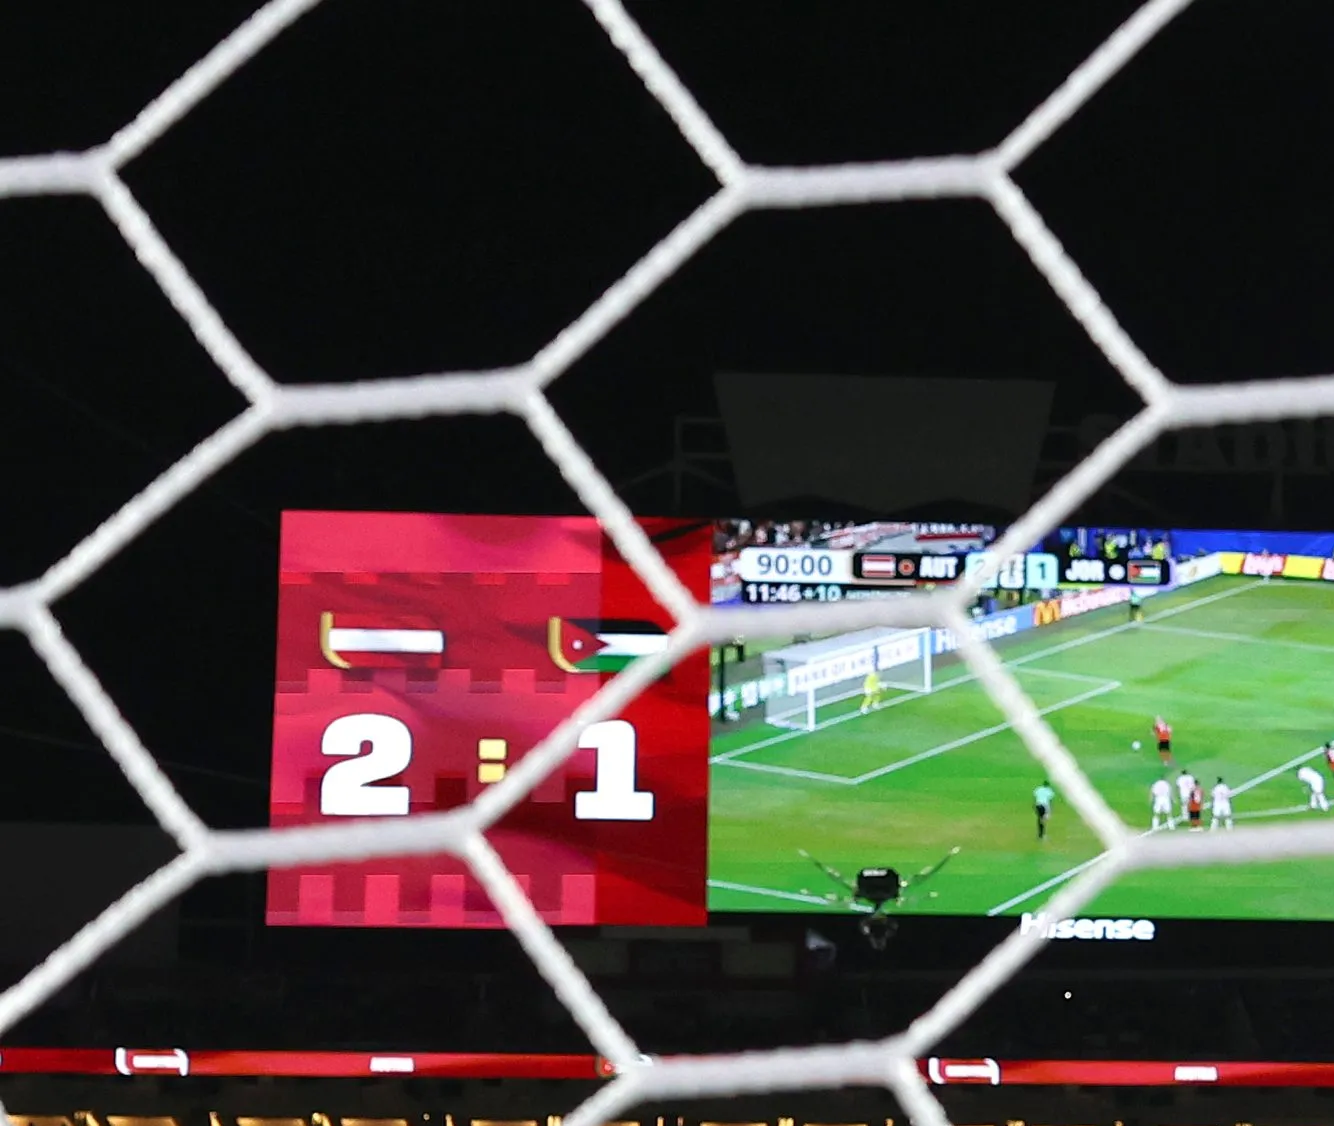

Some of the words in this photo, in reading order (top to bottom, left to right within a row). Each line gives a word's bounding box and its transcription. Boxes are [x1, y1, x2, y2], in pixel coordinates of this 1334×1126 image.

[757, 554, 833, 576] 90:00
[920, 556, 958, 578] AUT
[1037, 562, 1046, 580] 1
[1066, 559, 1105, 581] JOR
[746, 584, 800, 602] 11:46
[321, 713, 412, 815] 2
[575, 719, 655, 820] 1
[1020, 913, 1155, 940] Hisense
